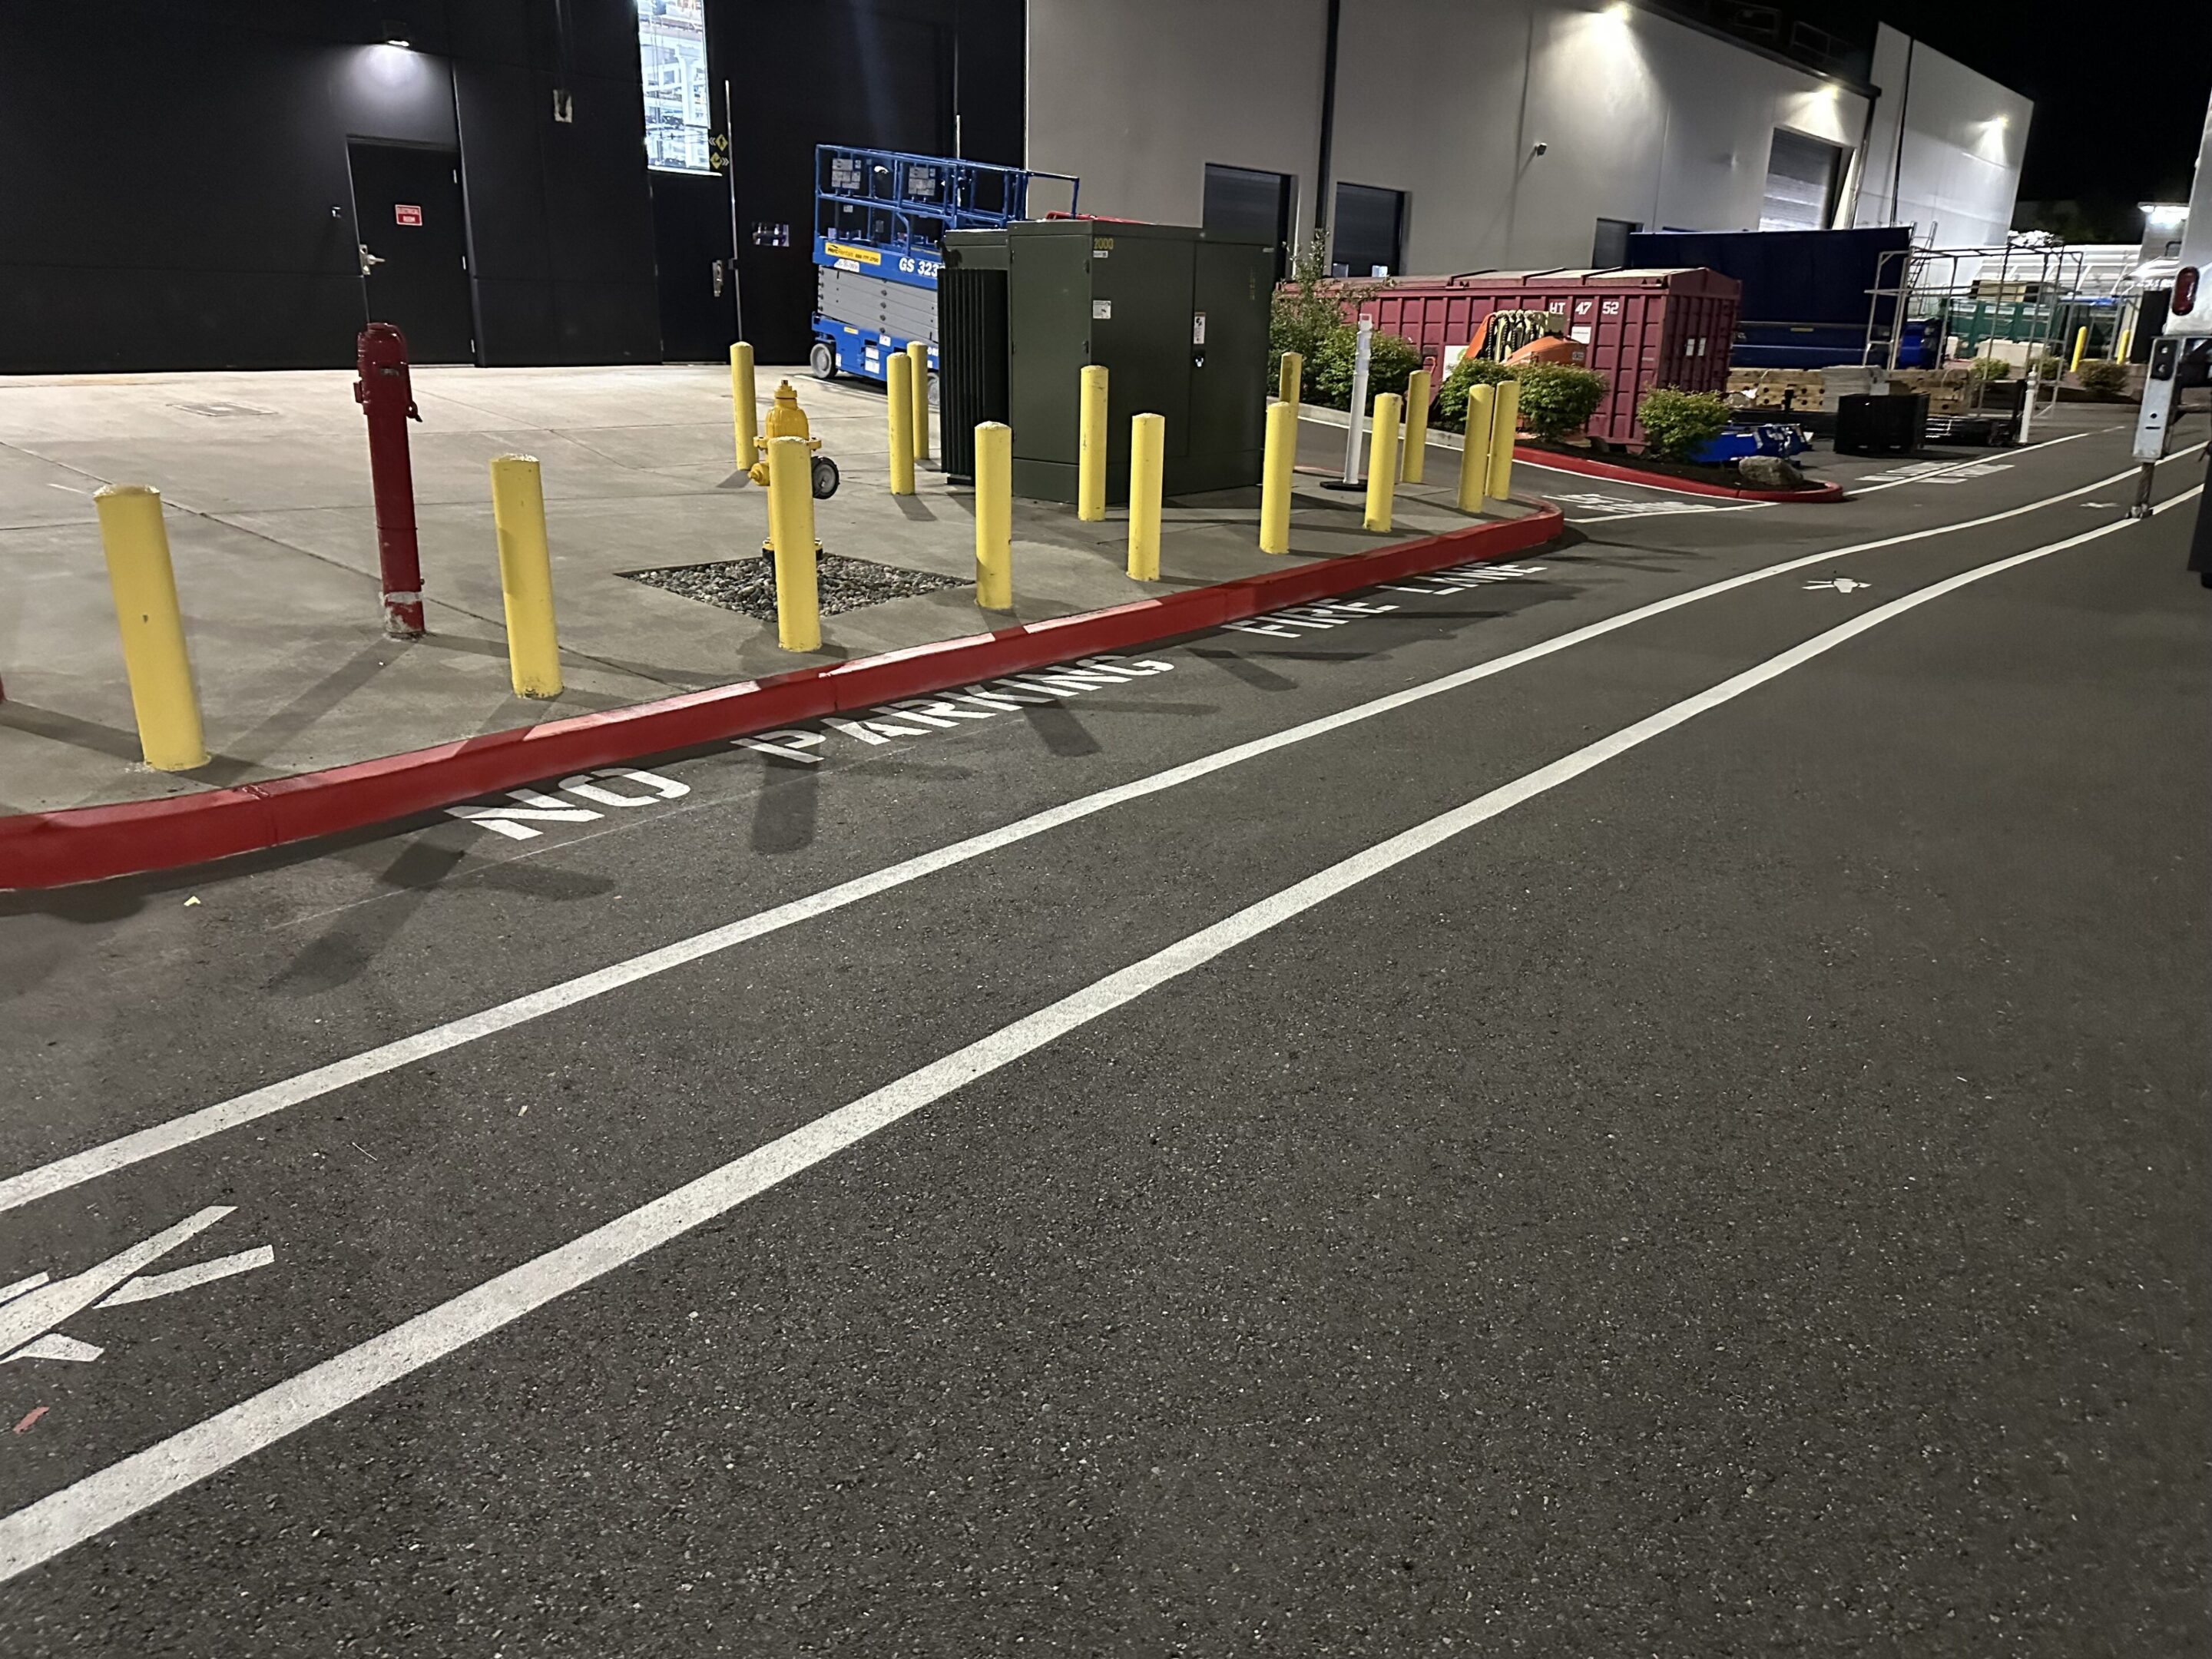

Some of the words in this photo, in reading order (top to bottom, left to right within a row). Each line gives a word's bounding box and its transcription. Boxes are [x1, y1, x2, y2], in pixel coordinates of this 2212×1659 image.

[1094, 238, 1114, 250] 2000
[899, 257, 916, 273] GS
[917, 261, 945, 278] 323
[1575, 301, 1592, 315] 47
[1602, 301, 1620, 315] 52
[443, 767, 691, 836] NO
[730, 654, 1174, 763] PARKING
[1220, 598, 1401, 638] FIRE
[1375, 561, 1548, 595] LANE
